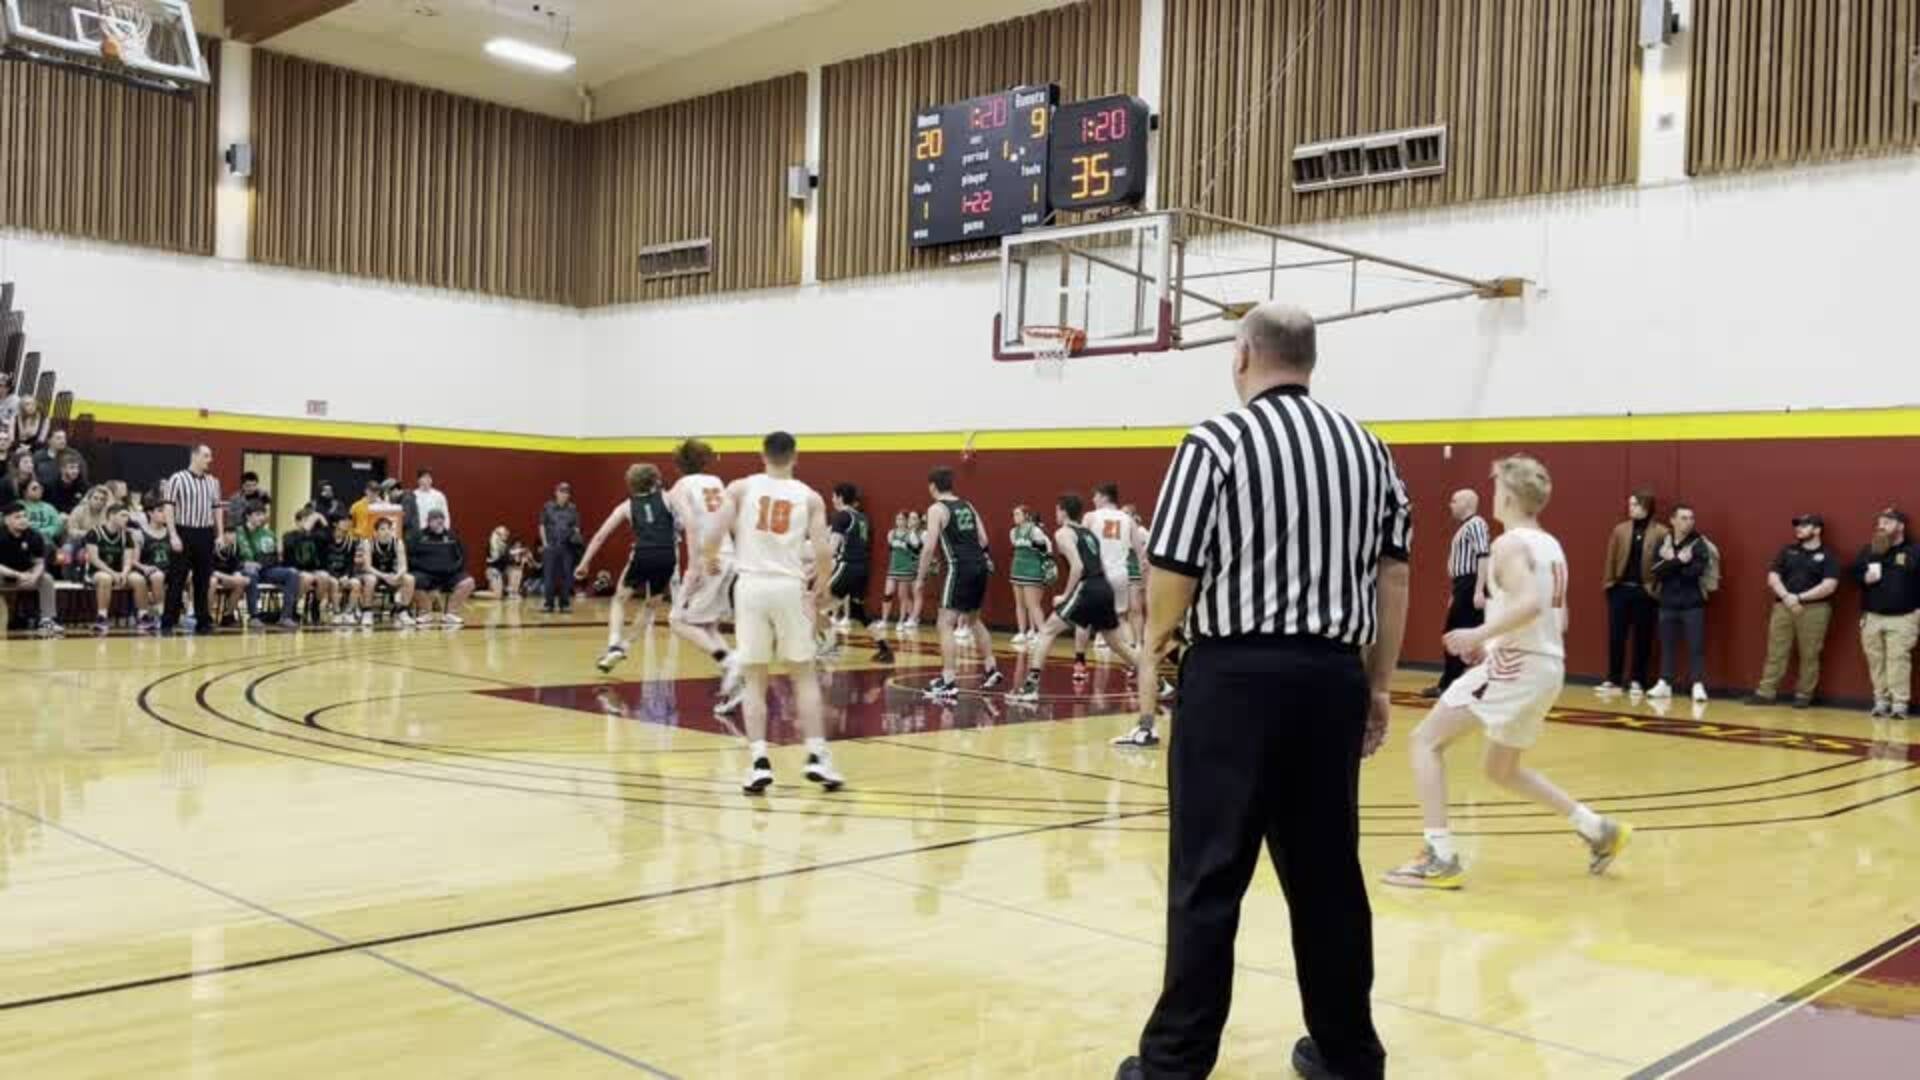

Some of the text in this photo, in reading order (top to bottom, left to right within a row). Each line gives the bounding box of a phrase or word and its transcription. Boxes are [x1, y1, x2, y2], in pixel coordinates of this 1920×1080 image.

[1030, 107, 1047, 139] 9
[1081, 109, 1127, 143] 1:20
[917, 128, 943, 160] 20
[962, 149, 990, 167] period
[961, 172, 989, 187] player
[1071, 152, 1111, 200] 35
[756, 495, 793, 535] 10
